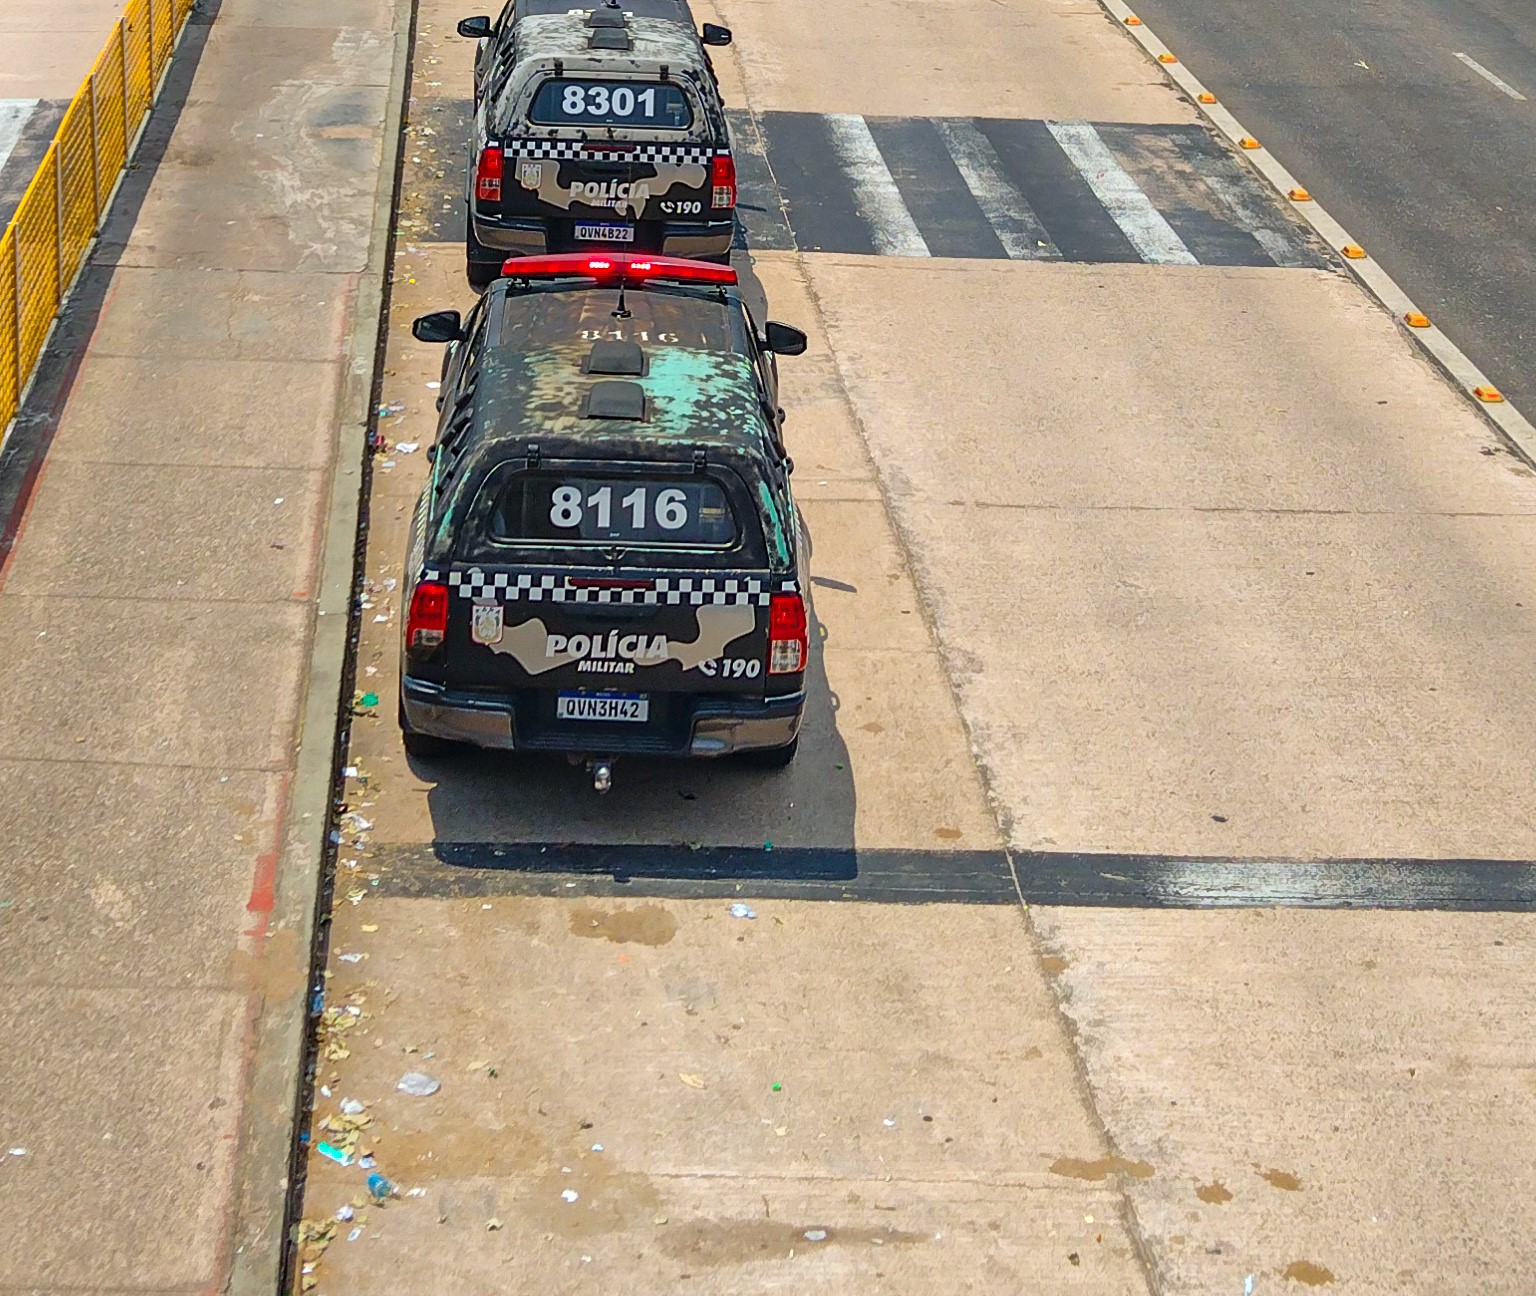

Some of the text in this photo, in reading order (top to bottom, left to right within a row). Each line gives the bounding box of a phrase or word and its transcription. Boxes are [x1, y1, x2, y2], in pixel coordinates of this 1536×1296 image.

[562, 85, 655, 117] 8301
[569, 179, 650, 199] POLÍCIA
[676, 201, 702, 214] 190
[580, 227, 629, 240] QVN4B22
[550, 486, 688, 529] 8116
[545, 629, 669, 659] POLÍCIA
[577, 660, 635, 674] MILITAR
[722, 659, 761, 678] 190
[566, 698, 639, 718] QVN3H42
